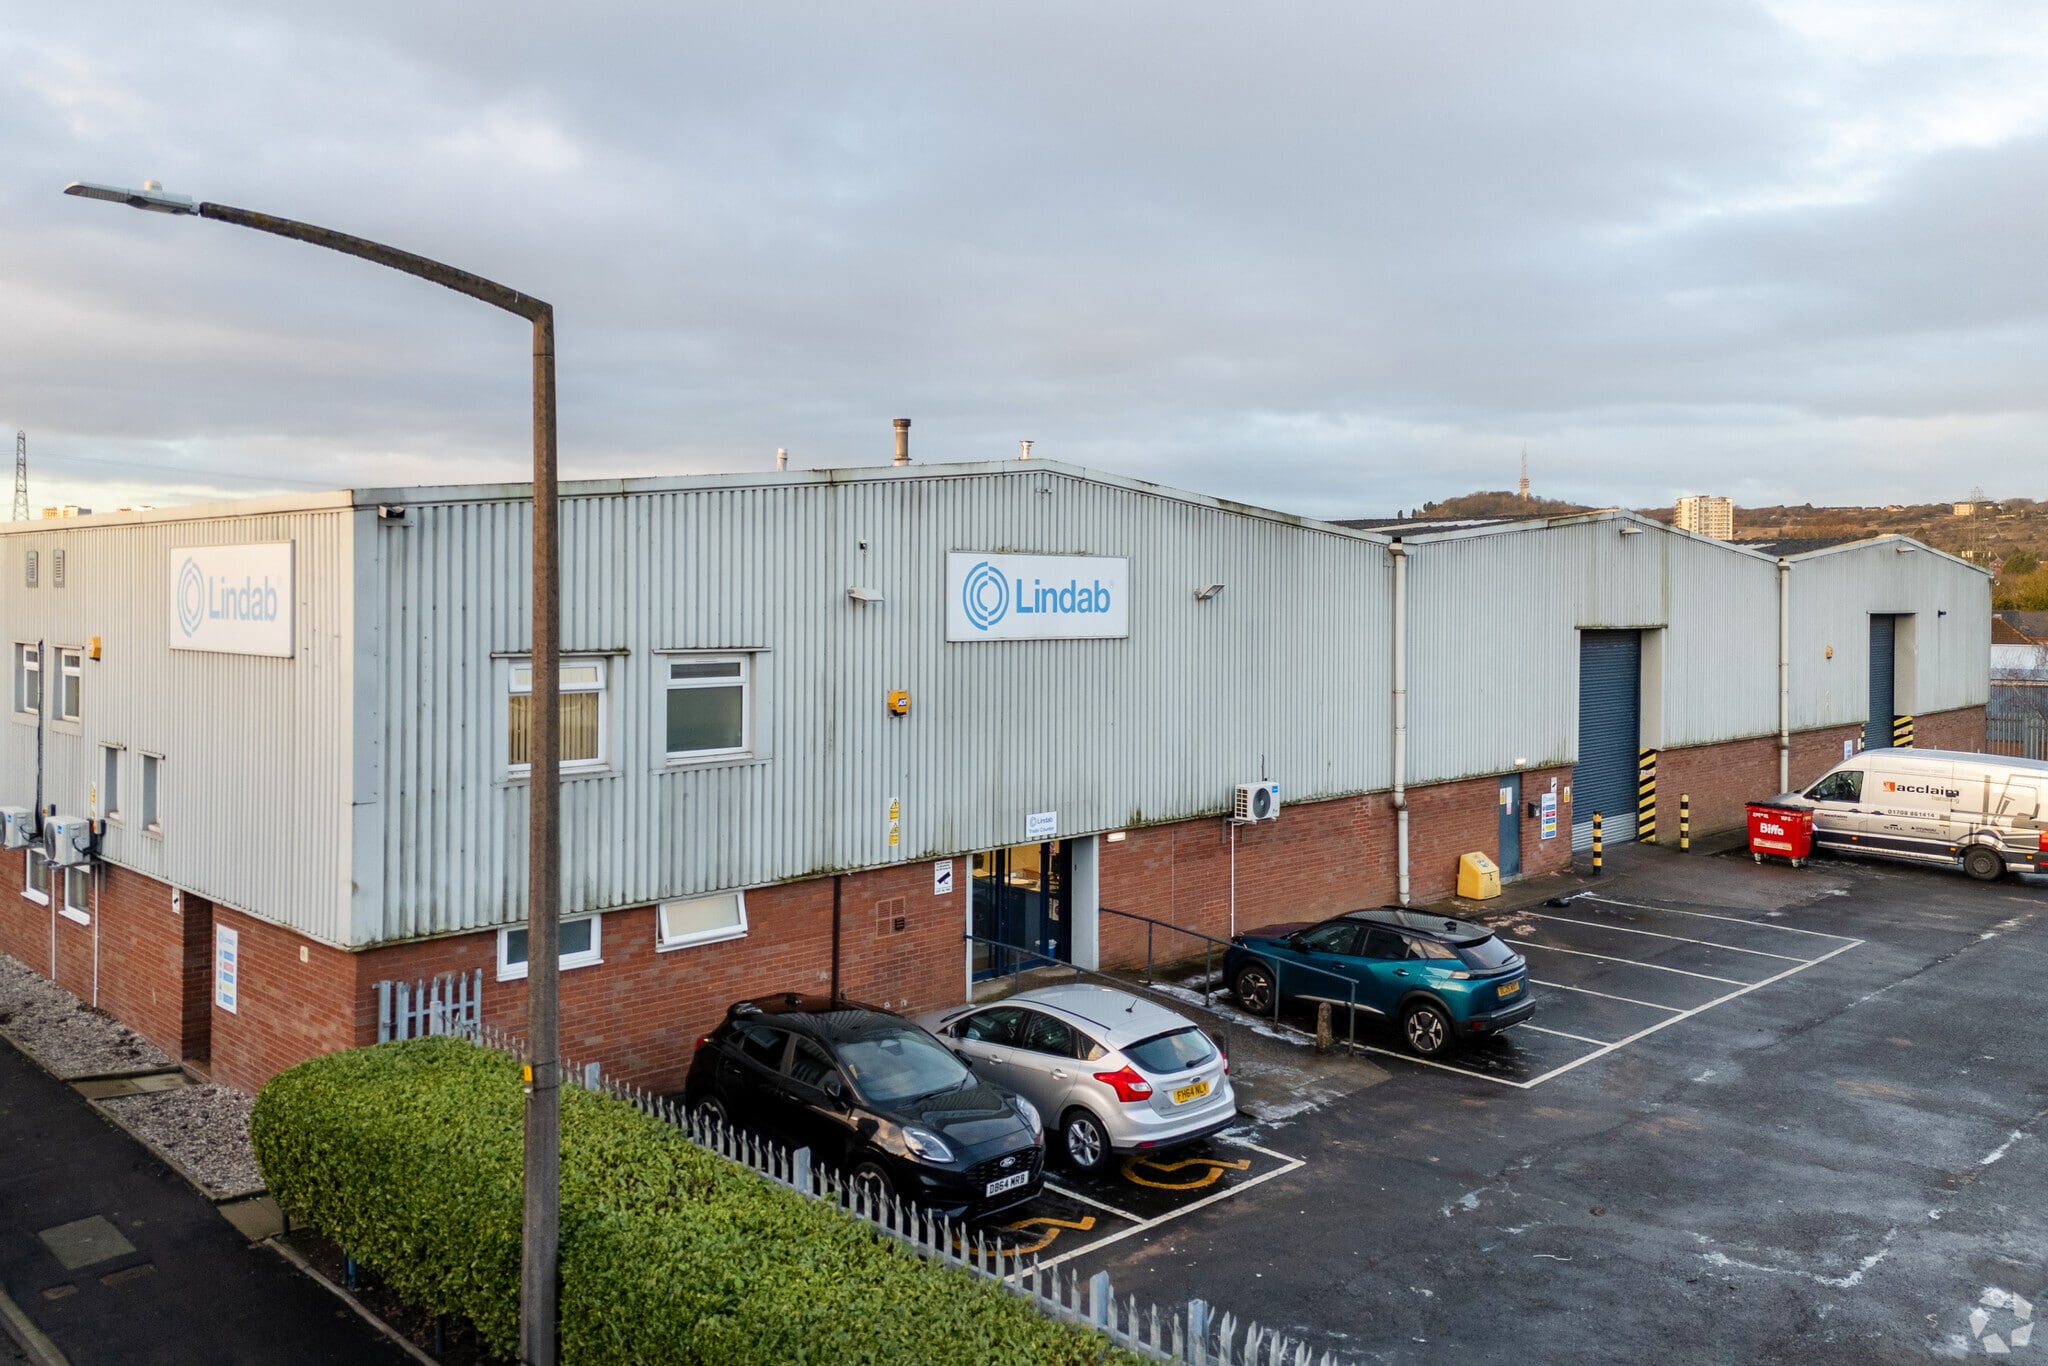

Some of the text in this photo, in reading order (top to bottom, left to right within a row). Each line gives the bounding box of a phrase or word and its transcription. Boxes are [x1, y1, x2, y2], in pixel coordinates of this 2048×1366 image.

[208, 576, 278, 622] Lindab
[1016, 578, 1111, 614] Lindab
[1896, 784, 1960, 797] acclaim
[1887, 808, 1909, 816] 01708
[1037, 816, 1053, 824] Lindab
[1760, 822, 1784, 836] Biffa
[989, 1179, 1009, 1194] DB64
